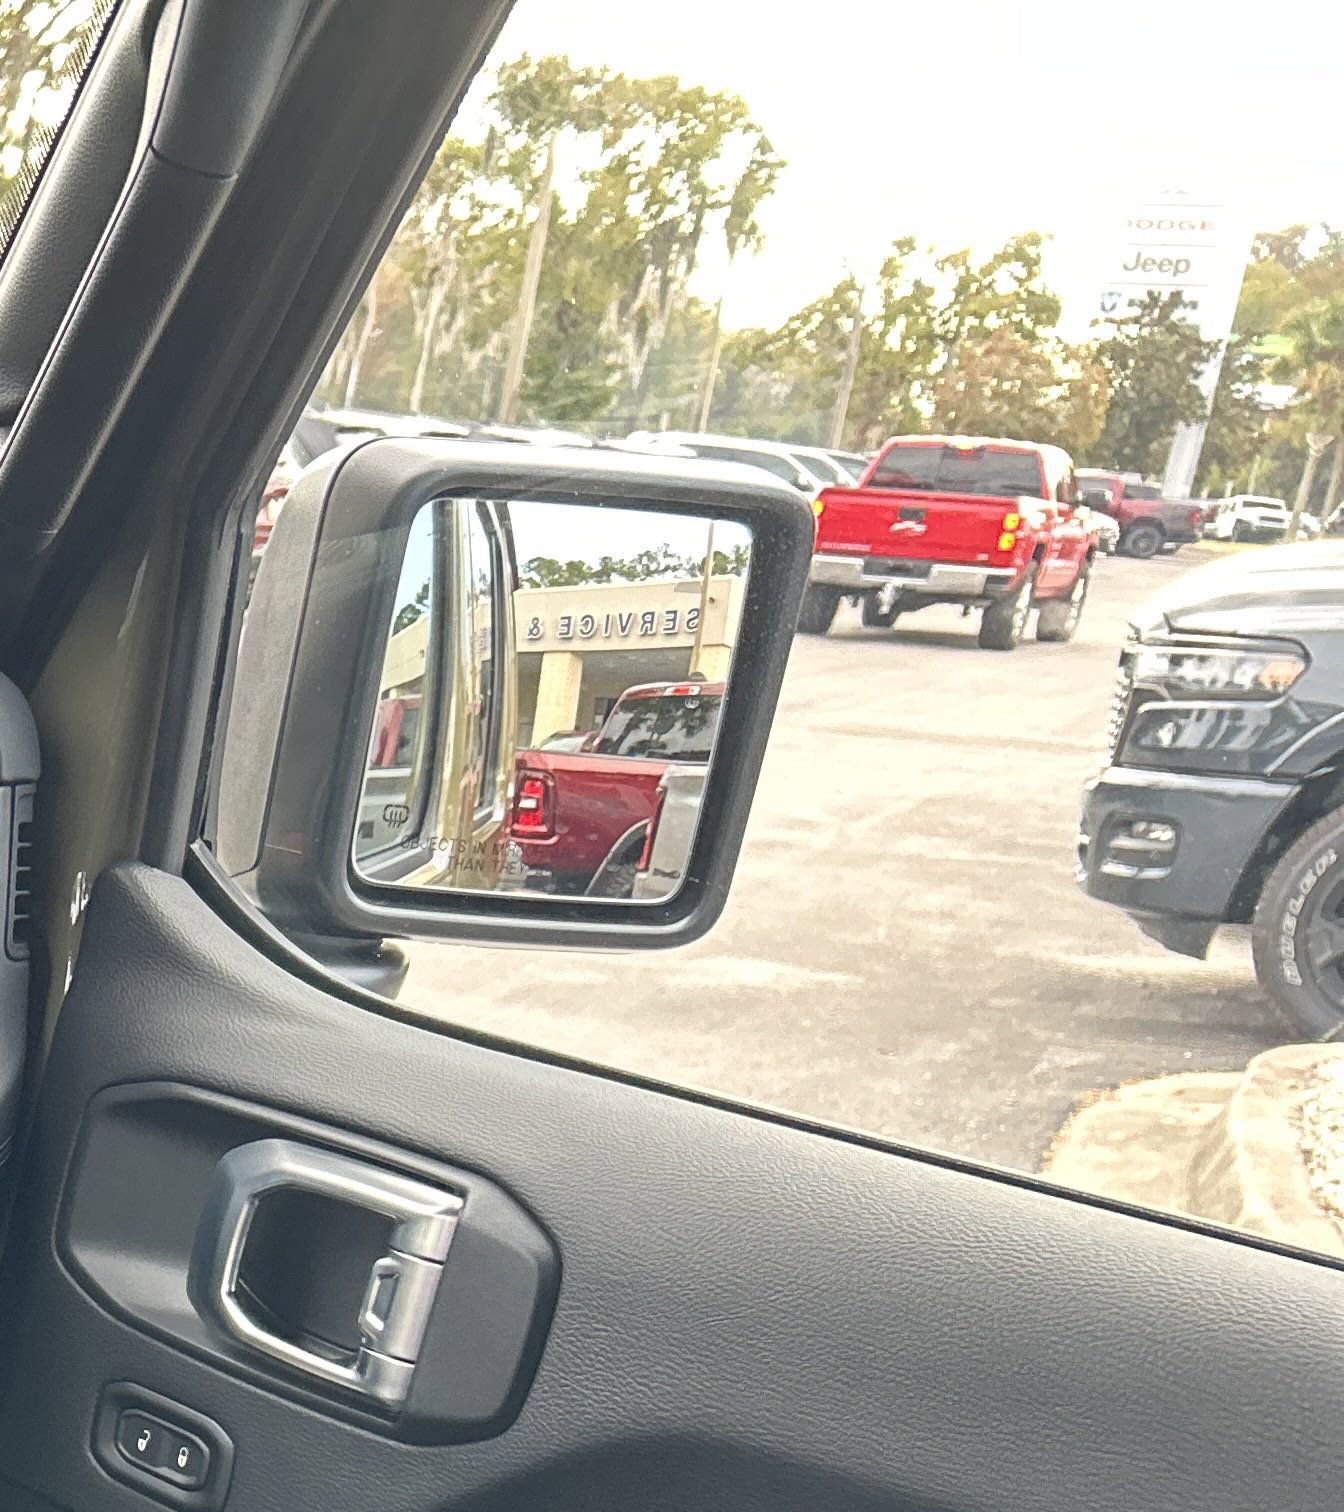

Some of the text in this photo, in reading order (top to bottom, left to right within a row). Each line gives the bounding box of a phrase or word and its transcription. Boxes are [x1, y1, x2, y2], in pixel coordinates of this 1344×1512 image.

[1123, 252, 1191, 277] Jeep
[400, 834, 466, 853] OBJECTS
[446, 855, 485, 873] THAN
